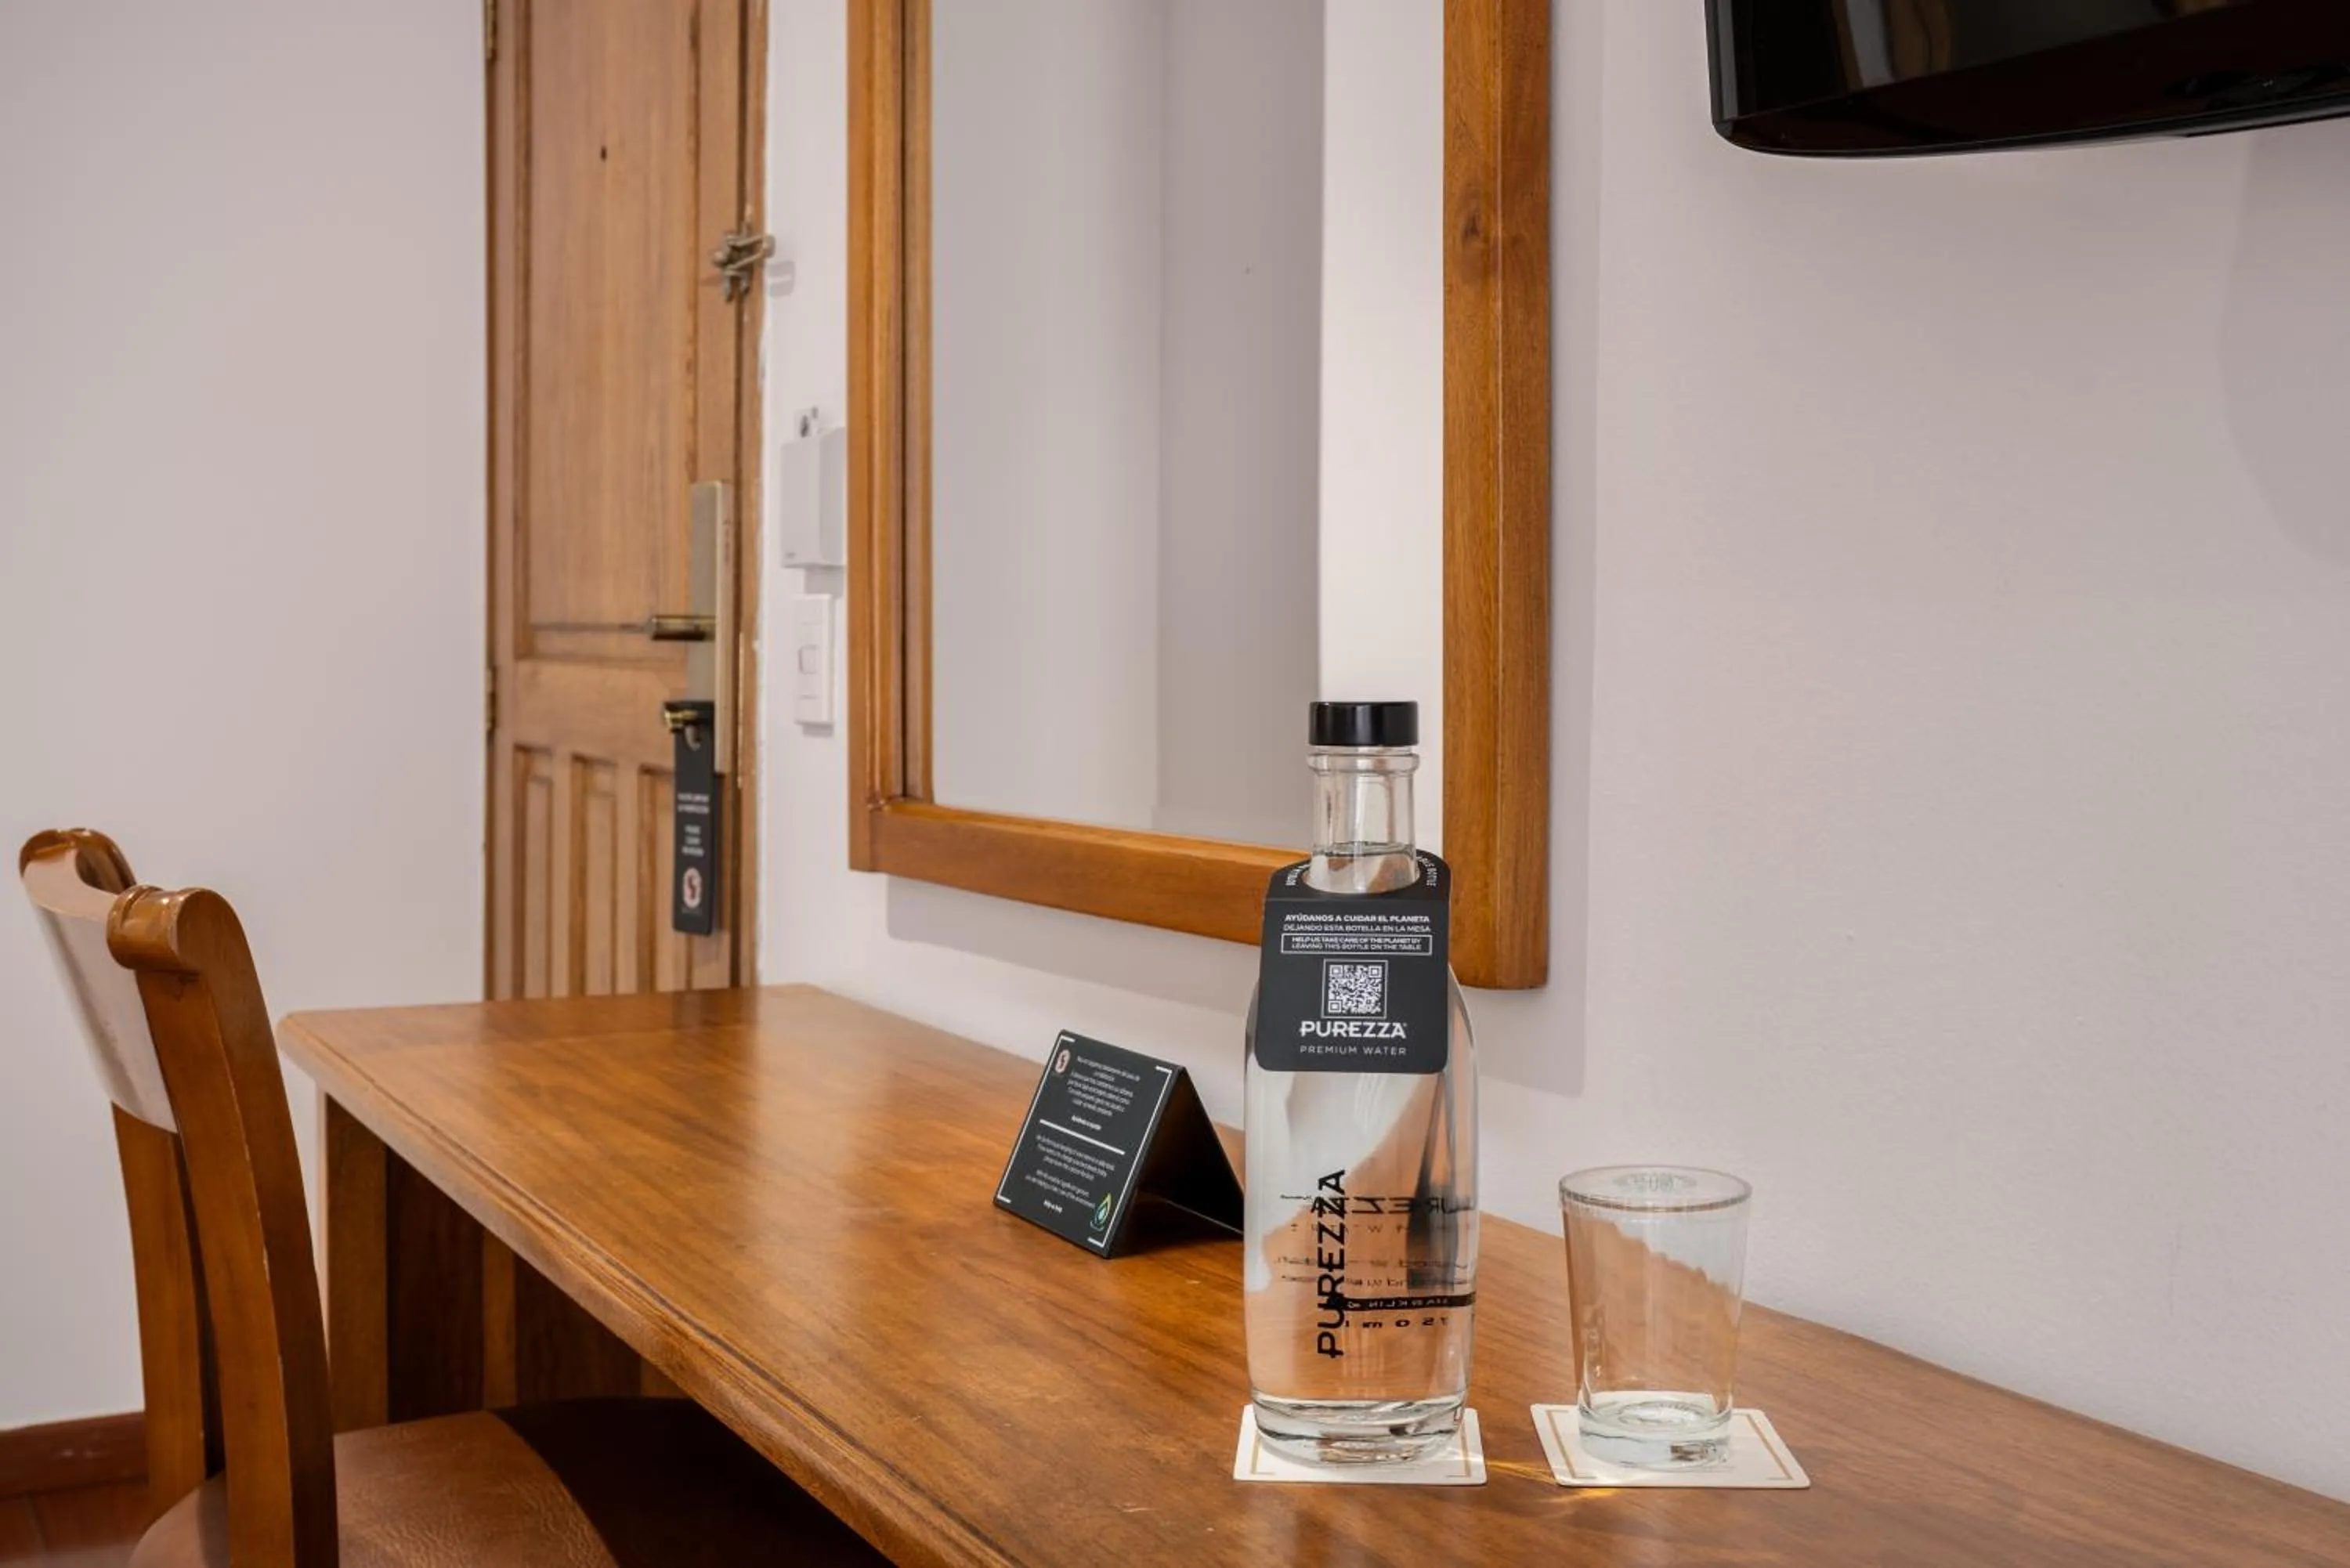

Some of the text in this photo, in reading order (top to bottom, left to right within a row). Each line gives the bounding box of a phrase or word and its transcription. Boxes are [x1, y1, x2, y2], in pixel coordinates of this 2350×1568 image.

[1285, 912, 1334, 922] AYÚDANOS
[1343, 914, 1376, 923] CUIDAR
[1300, 1021, 1407, 1039] PUREZZA
[1300, 1045, 1407, 1056] PREMIUM WATER
[1318, 1169, 1346, 1358] PUREZZA
